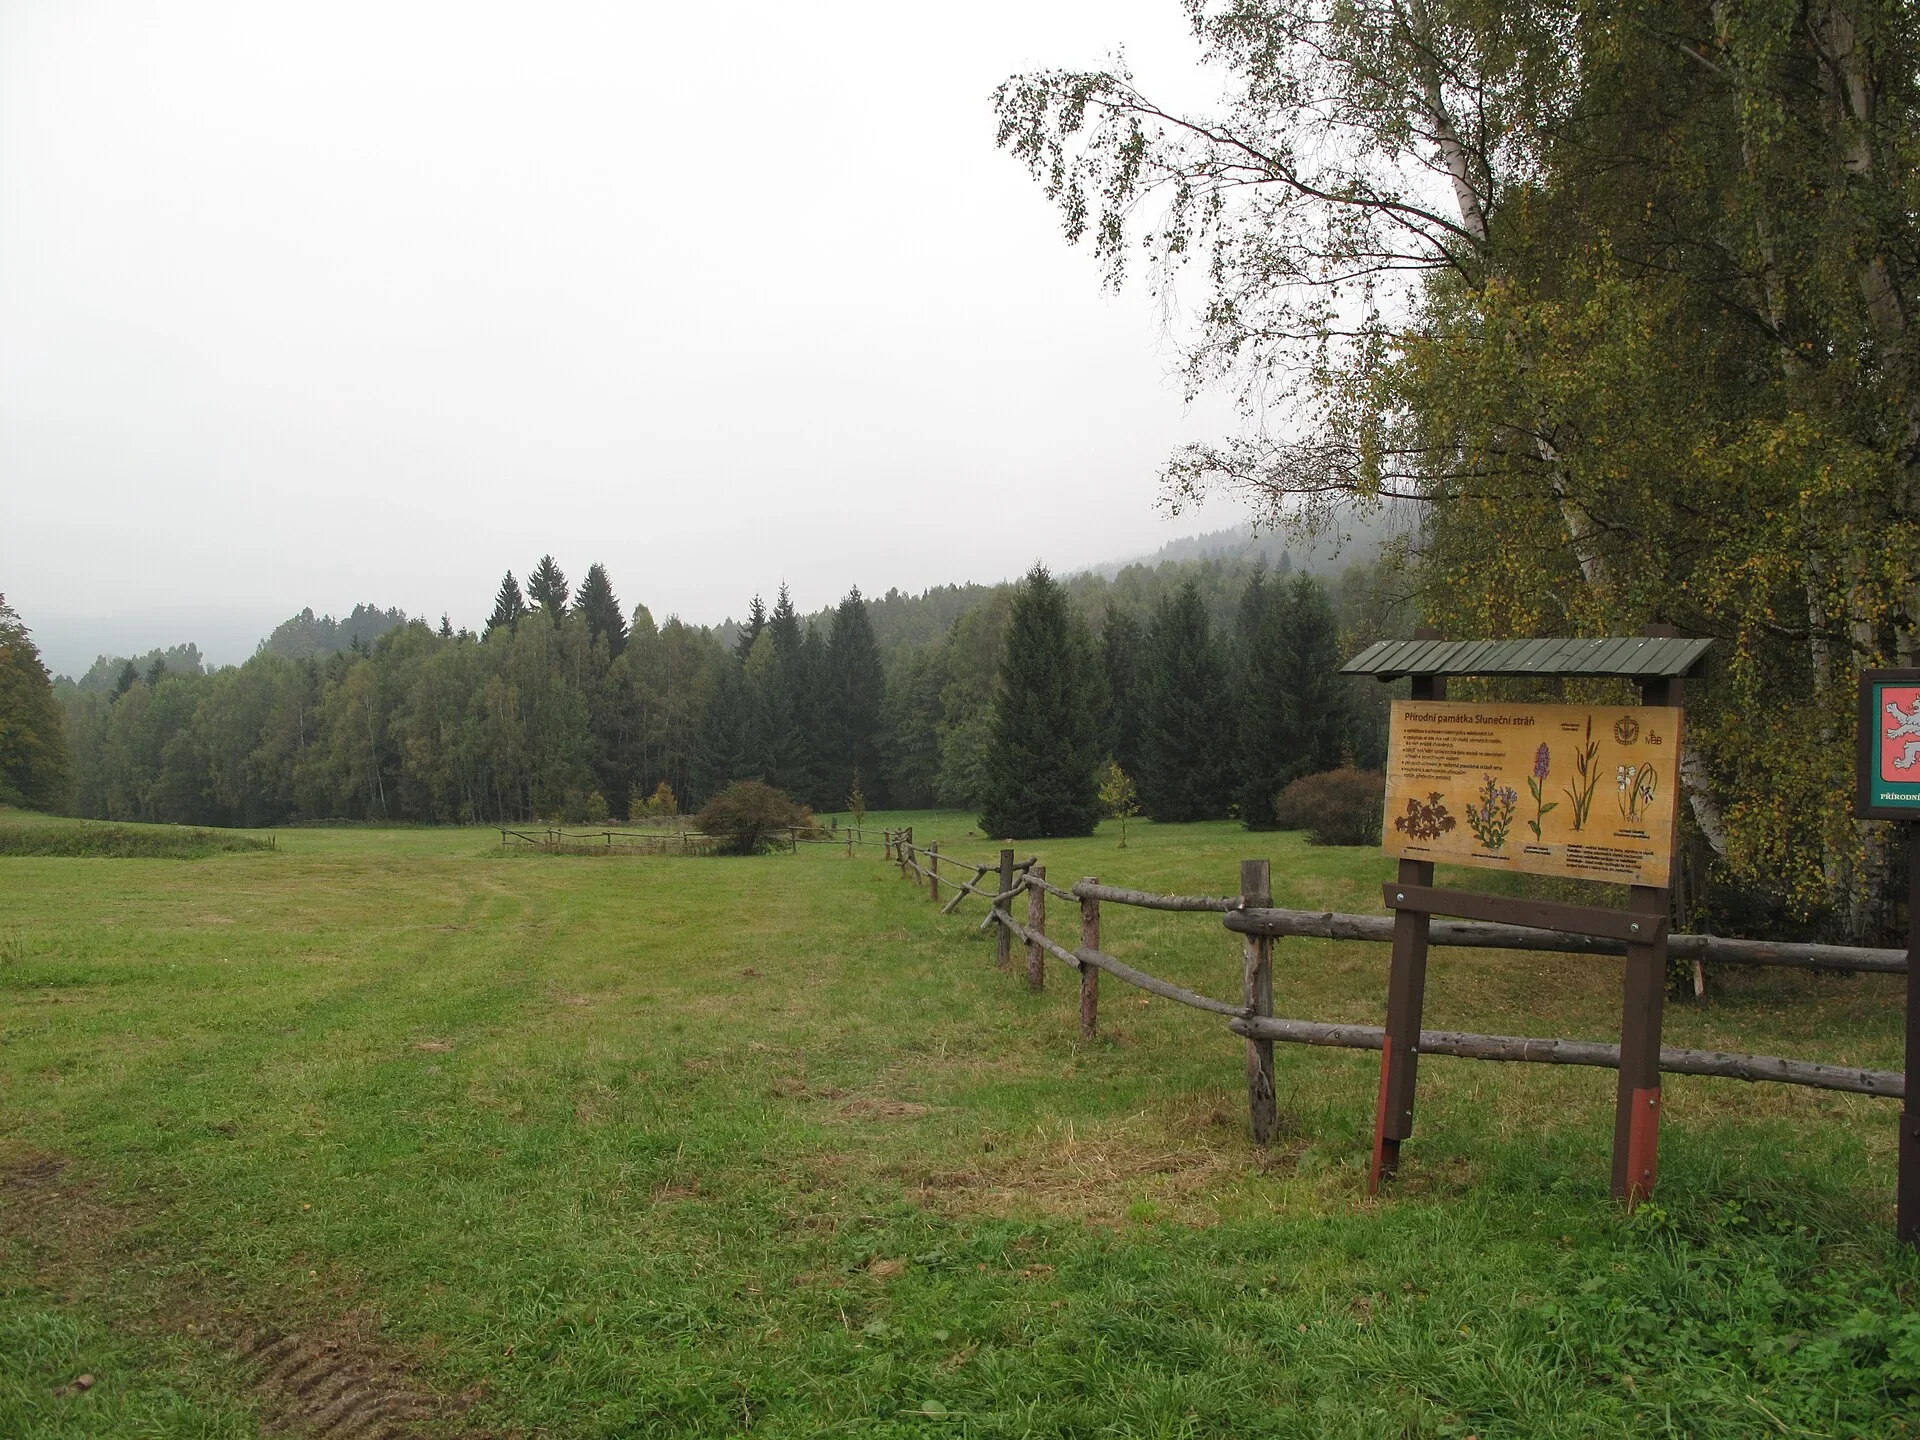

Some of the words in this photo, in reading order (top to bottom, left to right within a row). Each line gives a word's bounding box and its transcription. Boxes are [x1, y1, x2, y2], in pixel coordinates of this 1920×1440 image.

[1404, 712, 1437, 723] Přírodní
[1438, 714, 1473, 725] památka
[1474, 714, 1511, 725] Sluneční
[1512, 717, 1535, 726] stráň
